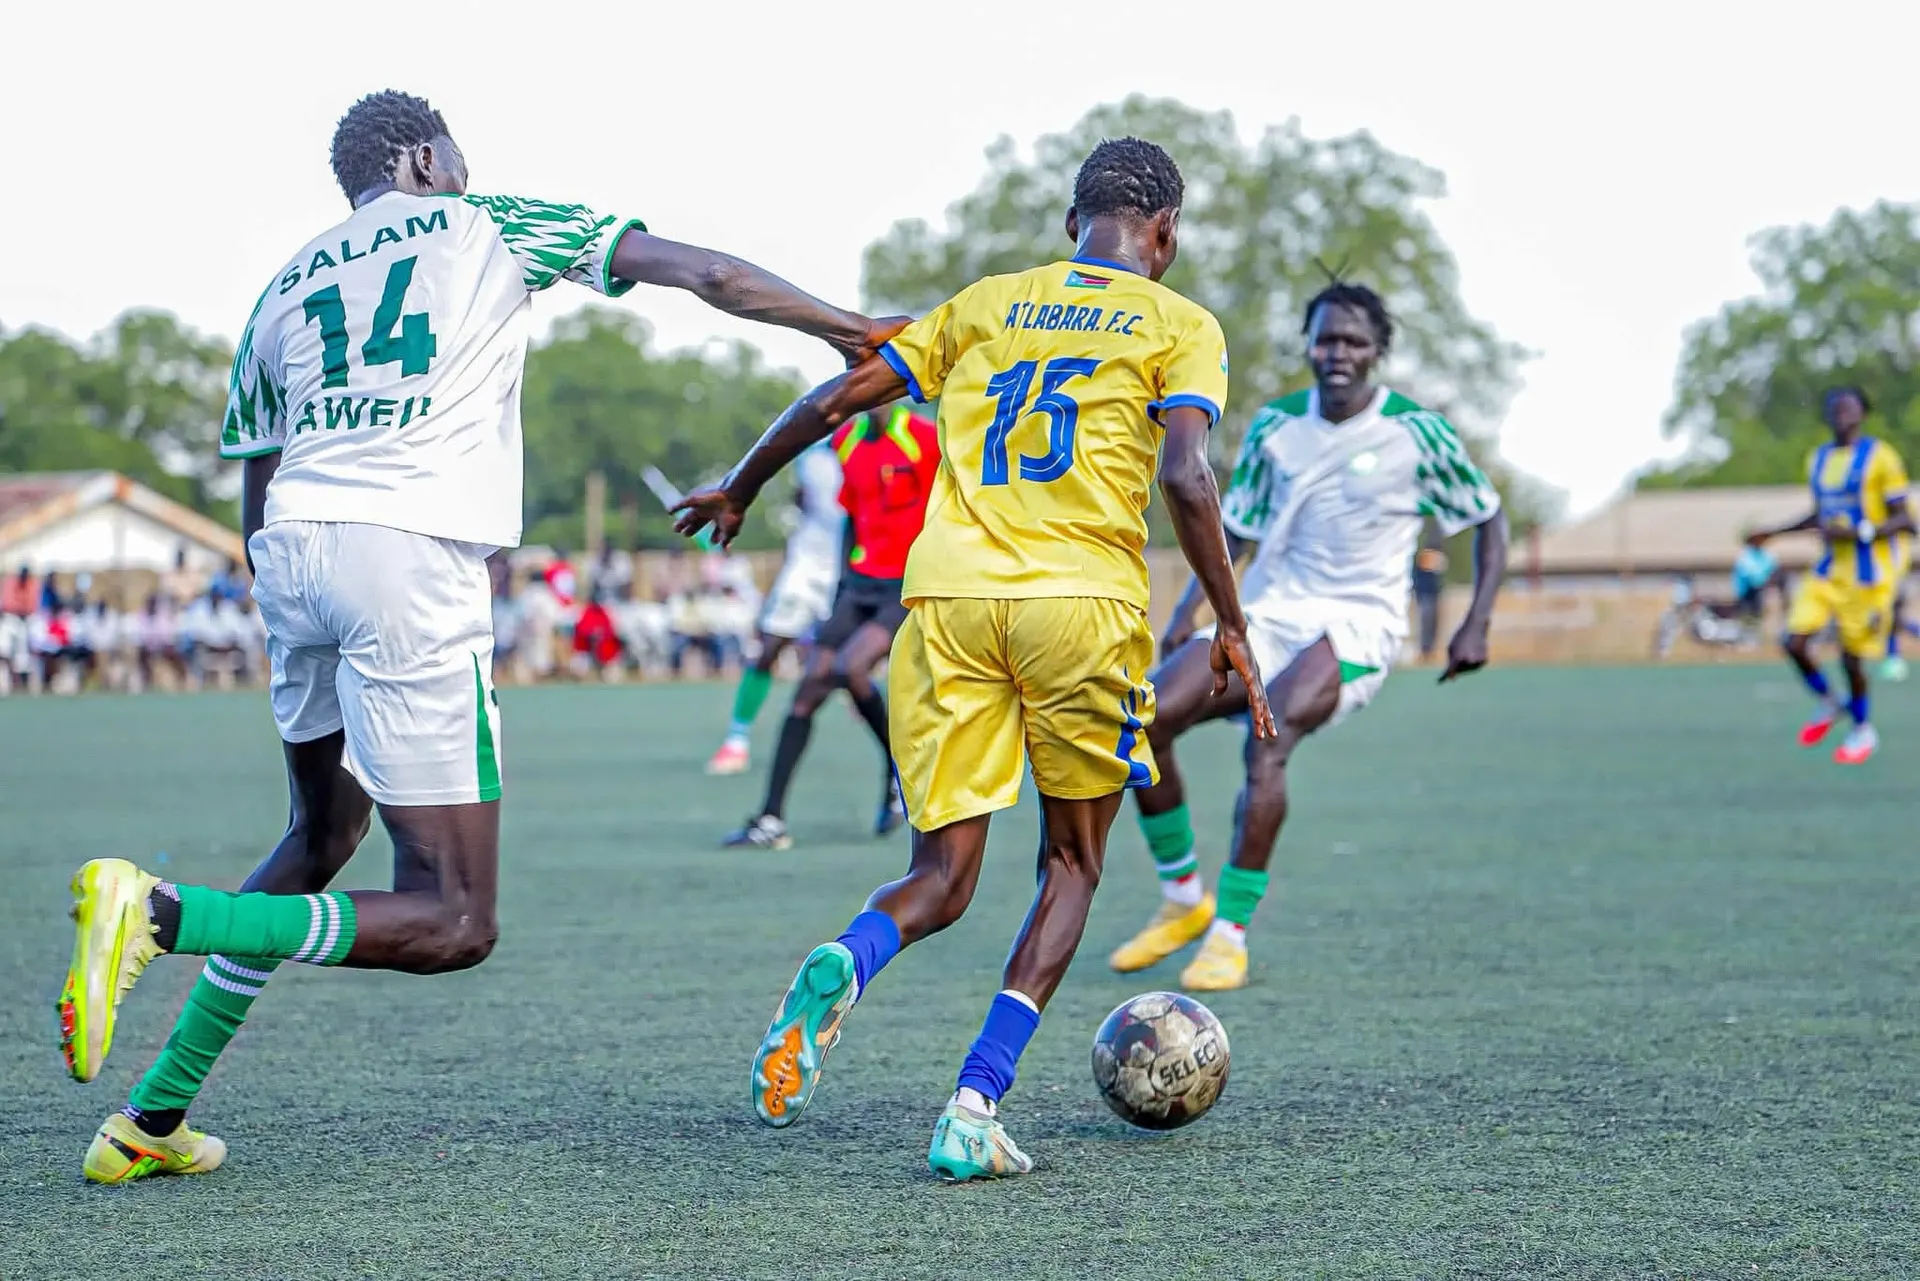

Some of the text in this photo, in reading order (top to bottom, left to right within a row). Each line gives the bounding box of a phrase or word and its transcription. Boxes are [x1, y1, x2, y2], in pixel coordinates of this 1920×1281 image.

[279, 208, 449, 296] SALAM
[302, 255, 437, 390] 14
[981, 356, 1103, 486] 15
